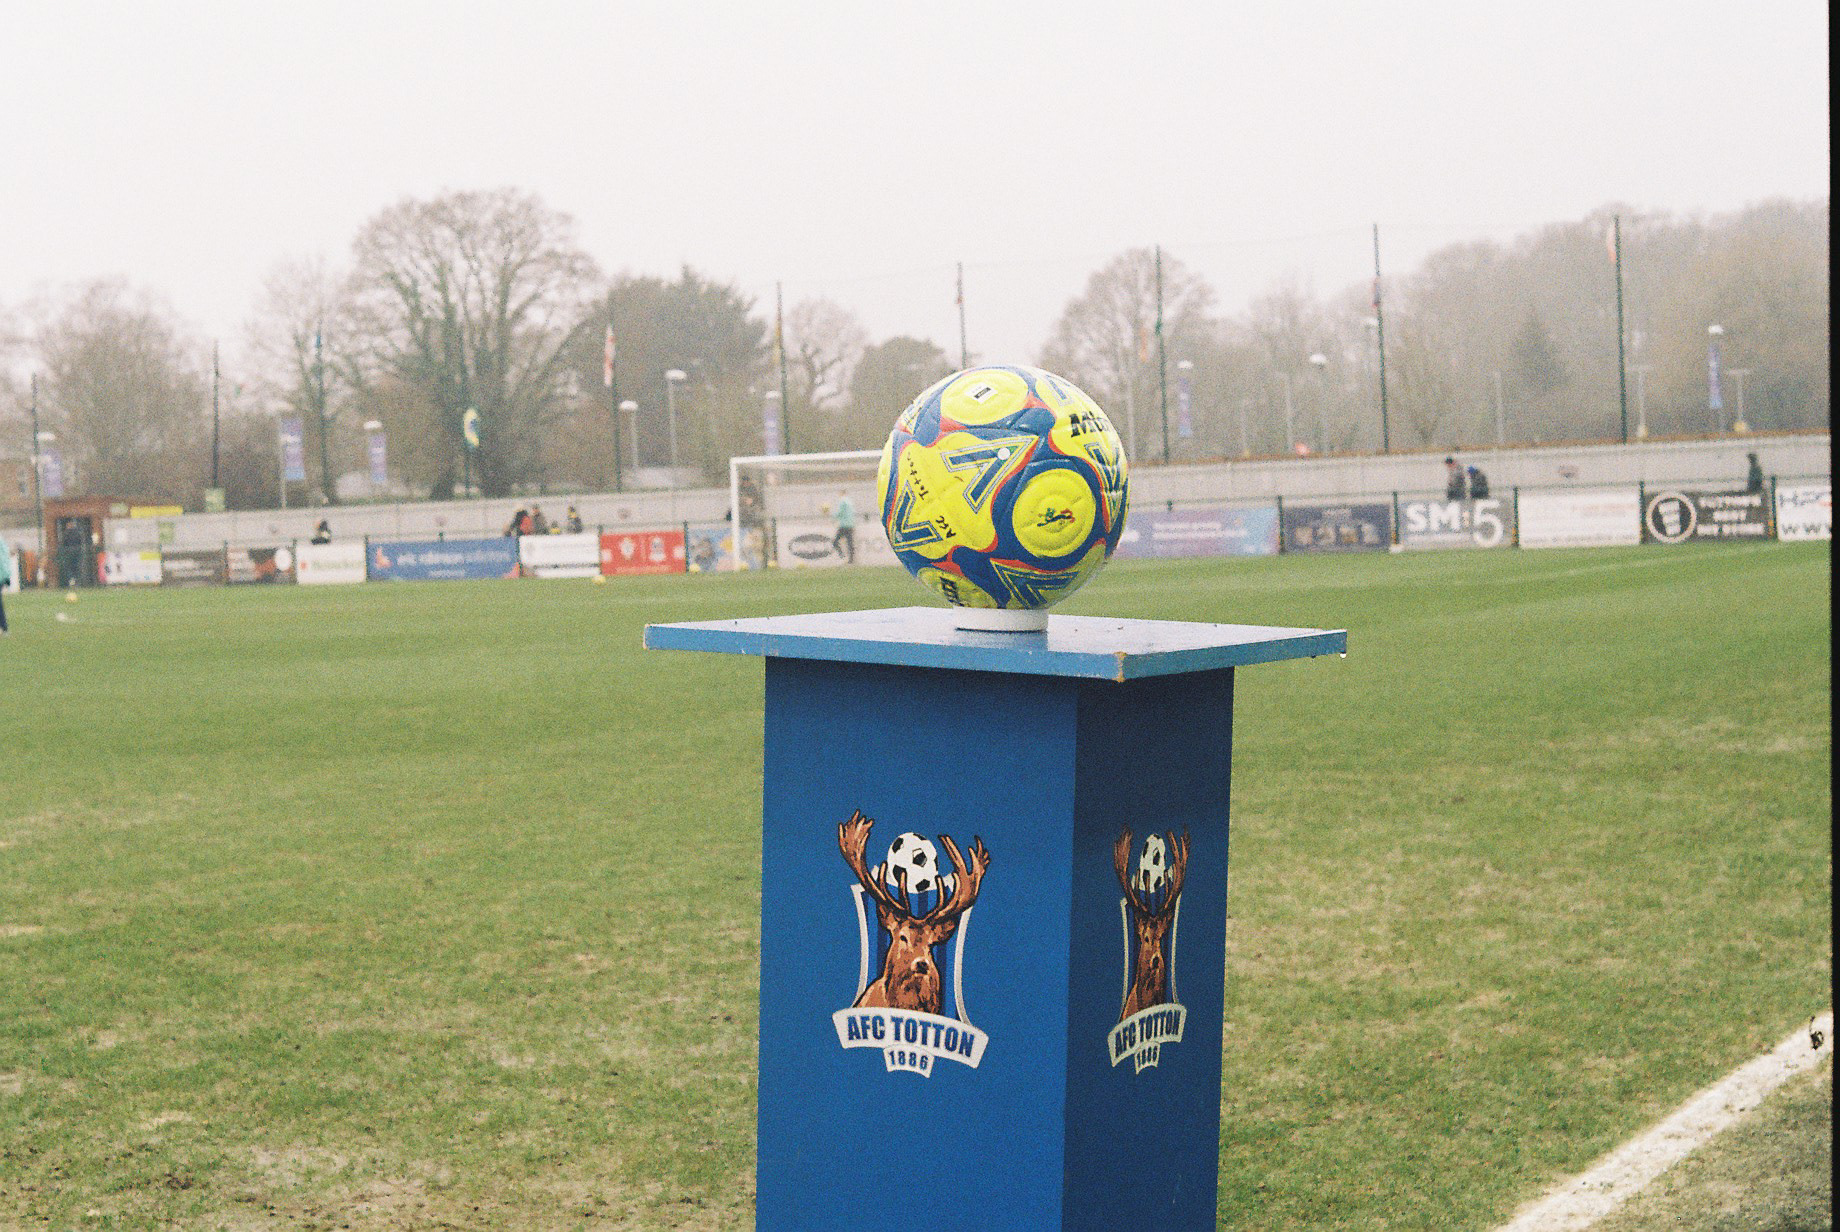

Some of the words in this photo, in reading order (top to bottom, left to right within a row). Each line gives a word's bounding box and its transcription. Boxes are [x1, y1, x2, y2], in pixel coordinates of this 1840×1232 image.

[847, 1015, 886, 1041] AFC
[889, 1016, 975, 1058] TOTTON
[1115, 1021, 1136, 1058] AFC
[1138, 1009, 1181, 1042] TOTTON
[887, 1050, 930, 1071] 1886
